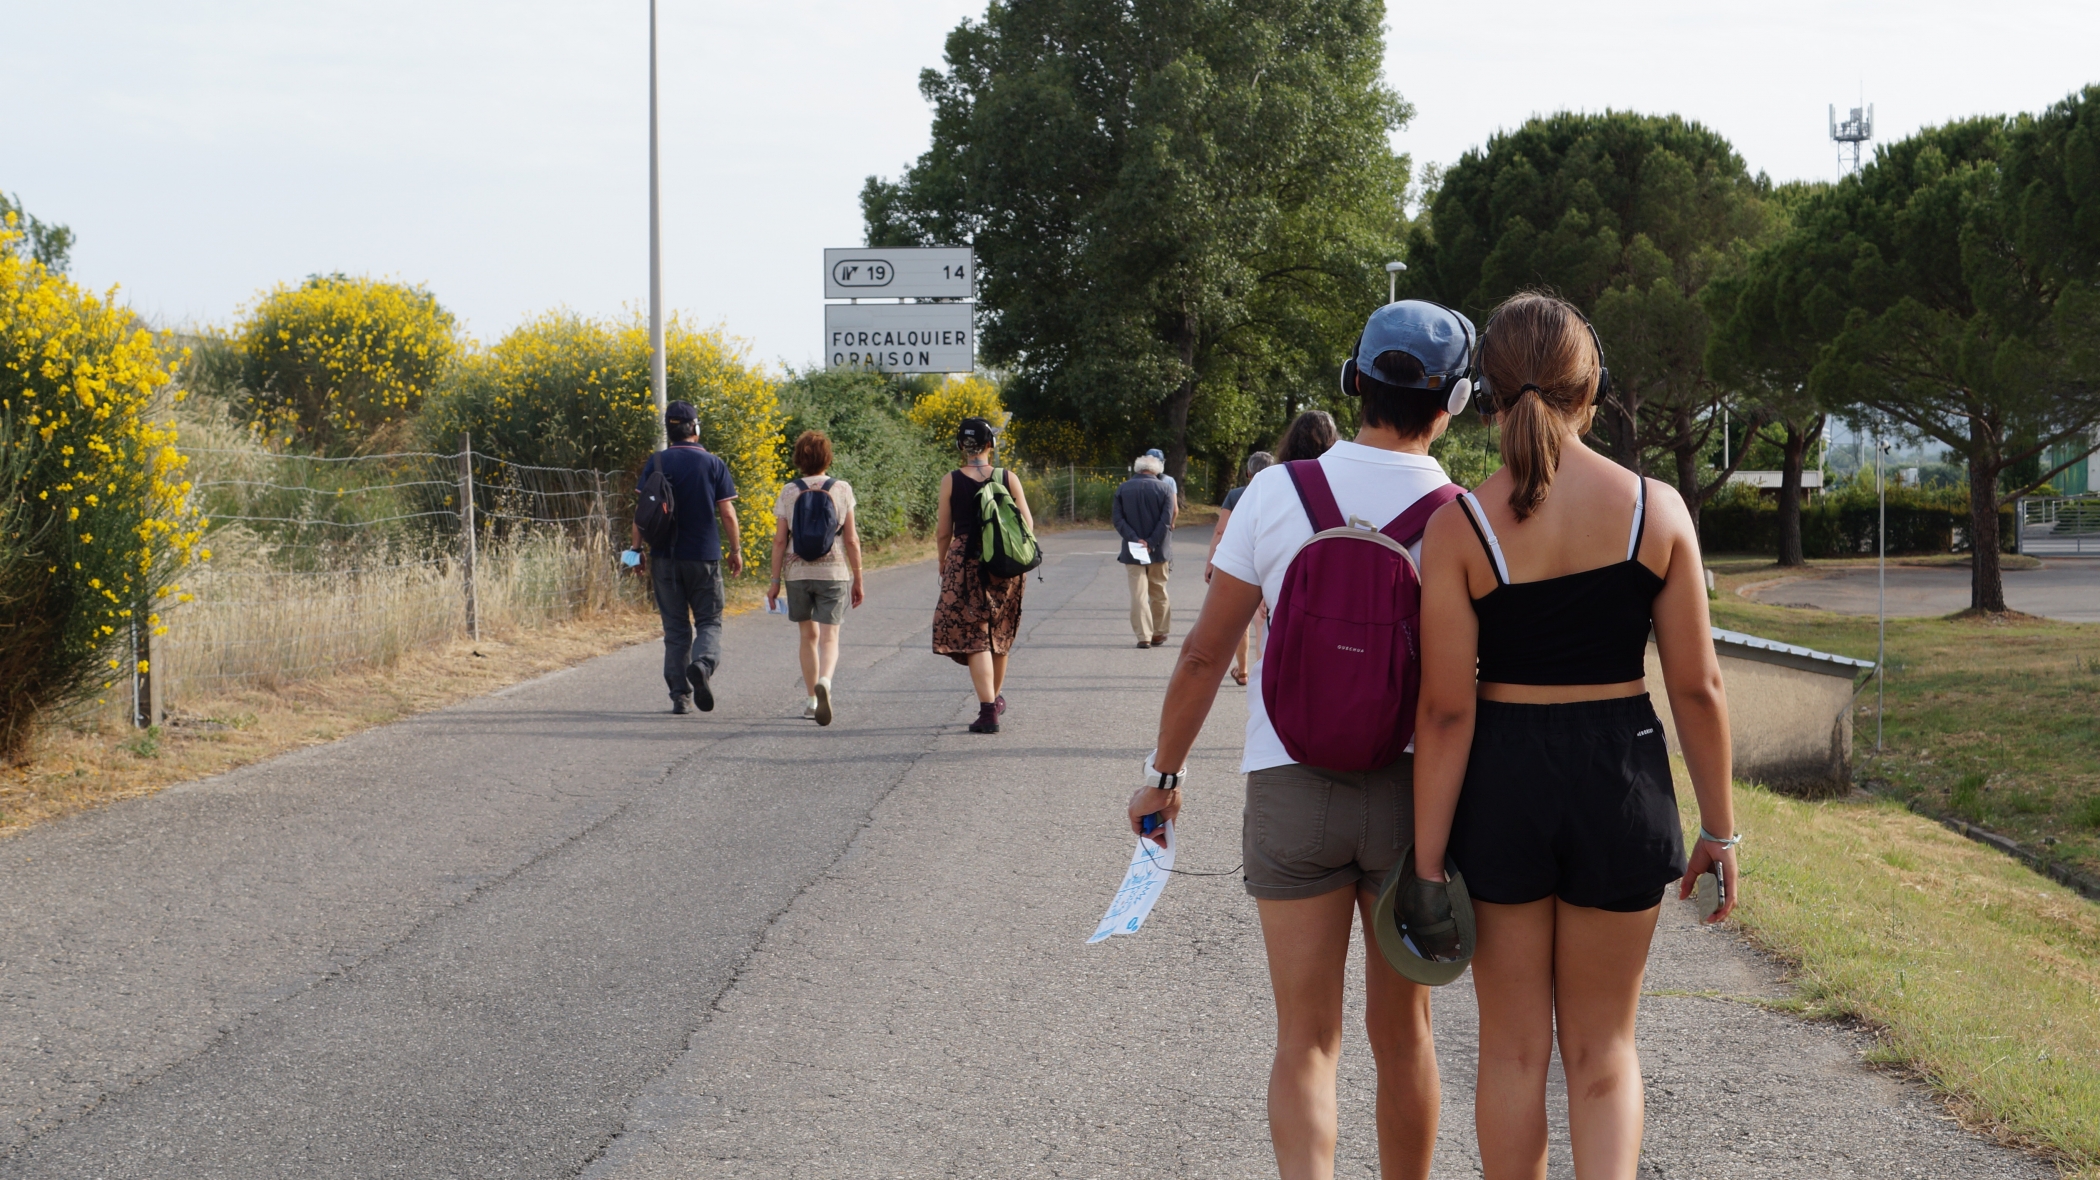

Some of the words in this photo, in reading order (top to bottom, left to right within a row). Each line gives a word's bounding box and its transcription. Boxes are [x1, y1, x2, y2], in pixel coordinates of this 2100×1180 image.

[867, 265, 886, 281] 19
[943, 265, 965, 280] 14
[832, 330, 966, 347] FORCALQUIER
[833, 351, 930, 366] ORAISON
